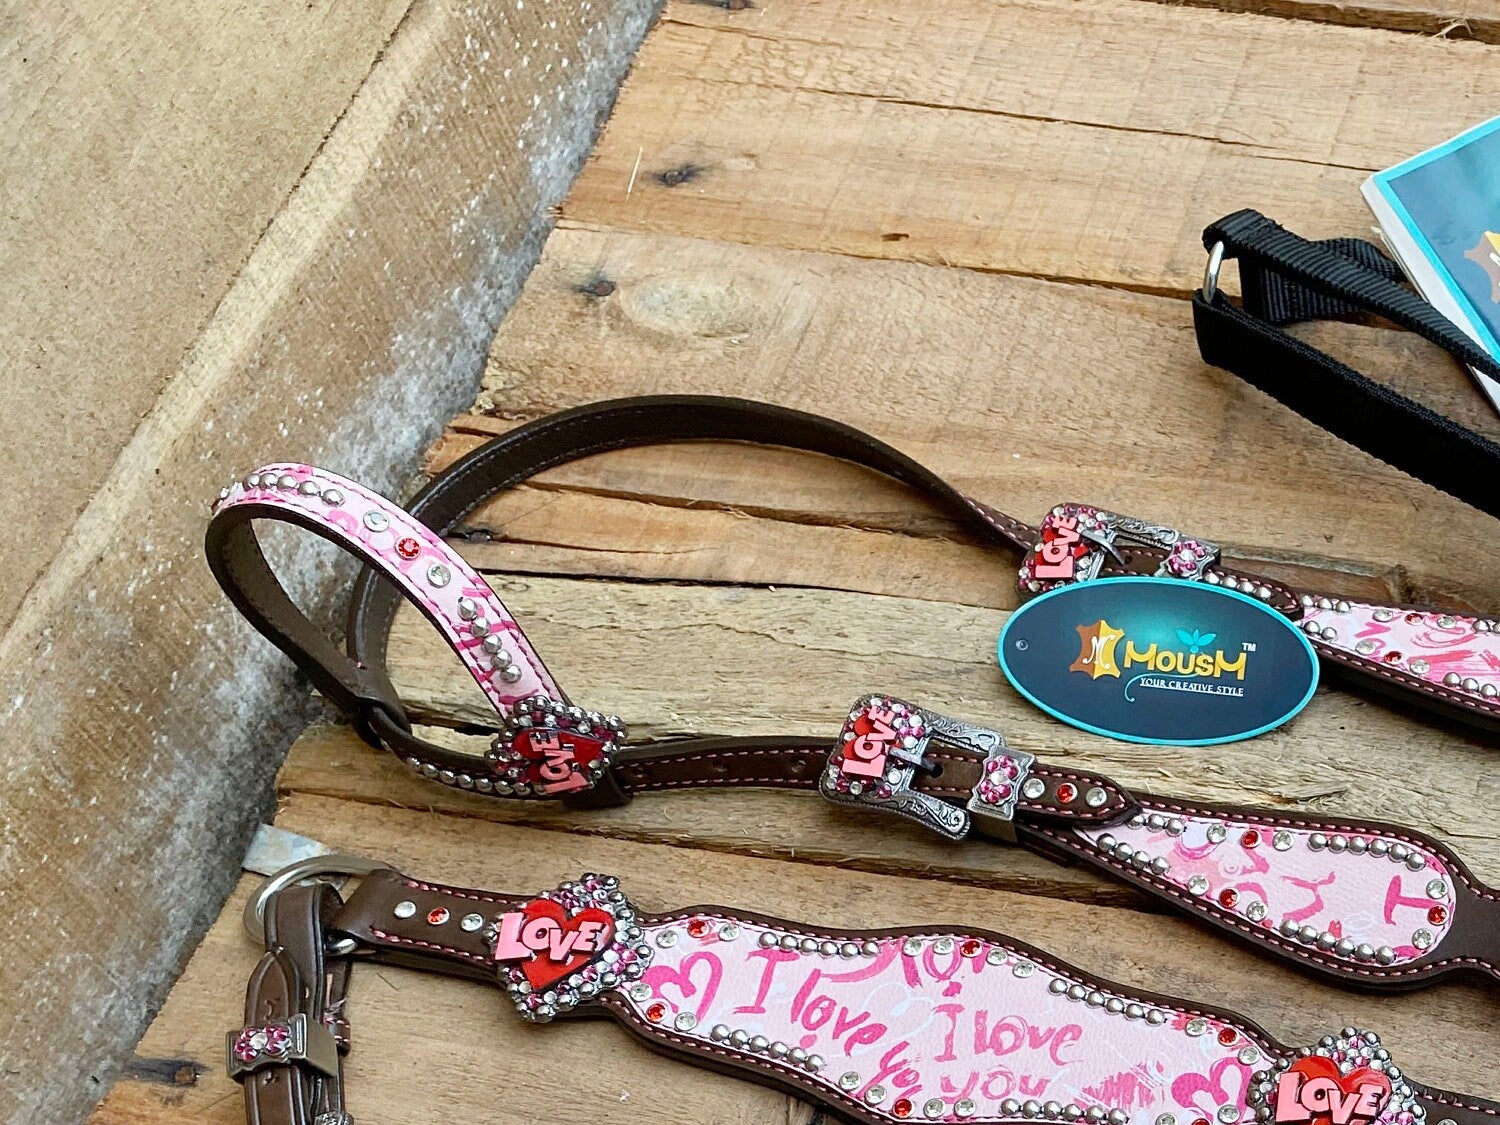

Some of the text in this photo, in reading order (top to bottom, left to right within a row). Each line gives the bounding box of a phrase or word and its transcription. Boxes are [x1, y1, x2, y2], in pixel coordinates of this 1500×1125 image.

[1034, 515, 1081, 580] LOVE
[1140, 677, 1244, 697] YOUR CREATIVE STYLE
[529, 731, 590, 794] LOVE
[842, 705, 897, 778] LOVE
[495, 911, 603, 964] LOVE
[933, 1003, 1084, 1067] I love
